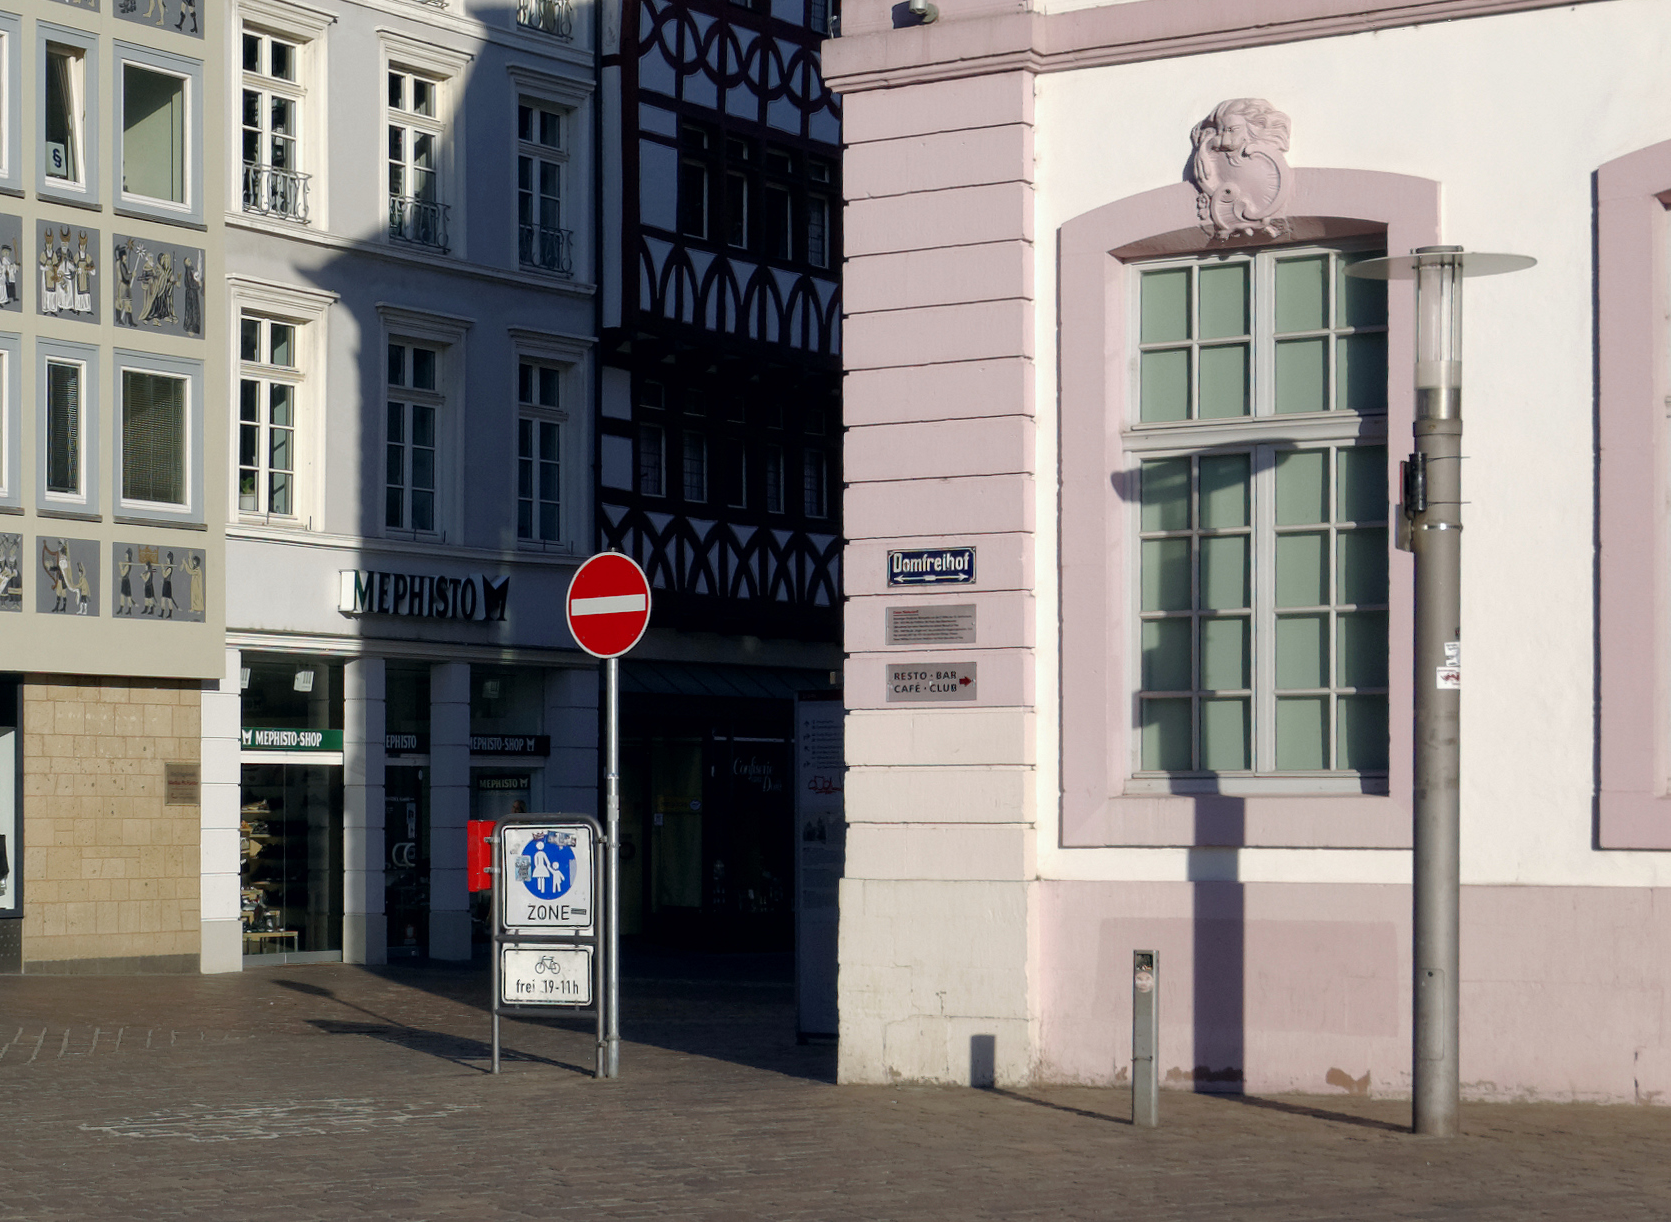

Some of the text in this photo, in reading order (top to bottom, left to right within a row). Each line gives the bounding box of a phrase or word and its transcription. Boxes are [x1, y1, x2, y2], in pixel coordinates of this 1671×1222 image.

[893, 552, 969, 573] Domfreihof
[355, 570, 477, 620] MEPHISTO
[894, 670, 957, 680] RESTO BAR
[894, 682, 957, 693] CAFÉ CLUB
[385, 734, 417, 749] EPHISTO
[479, 778, 518, 789] MEPHISTO
[527, 904, 570, 921] ZONE
[516, 979, 579, 995] frei 19-11h
